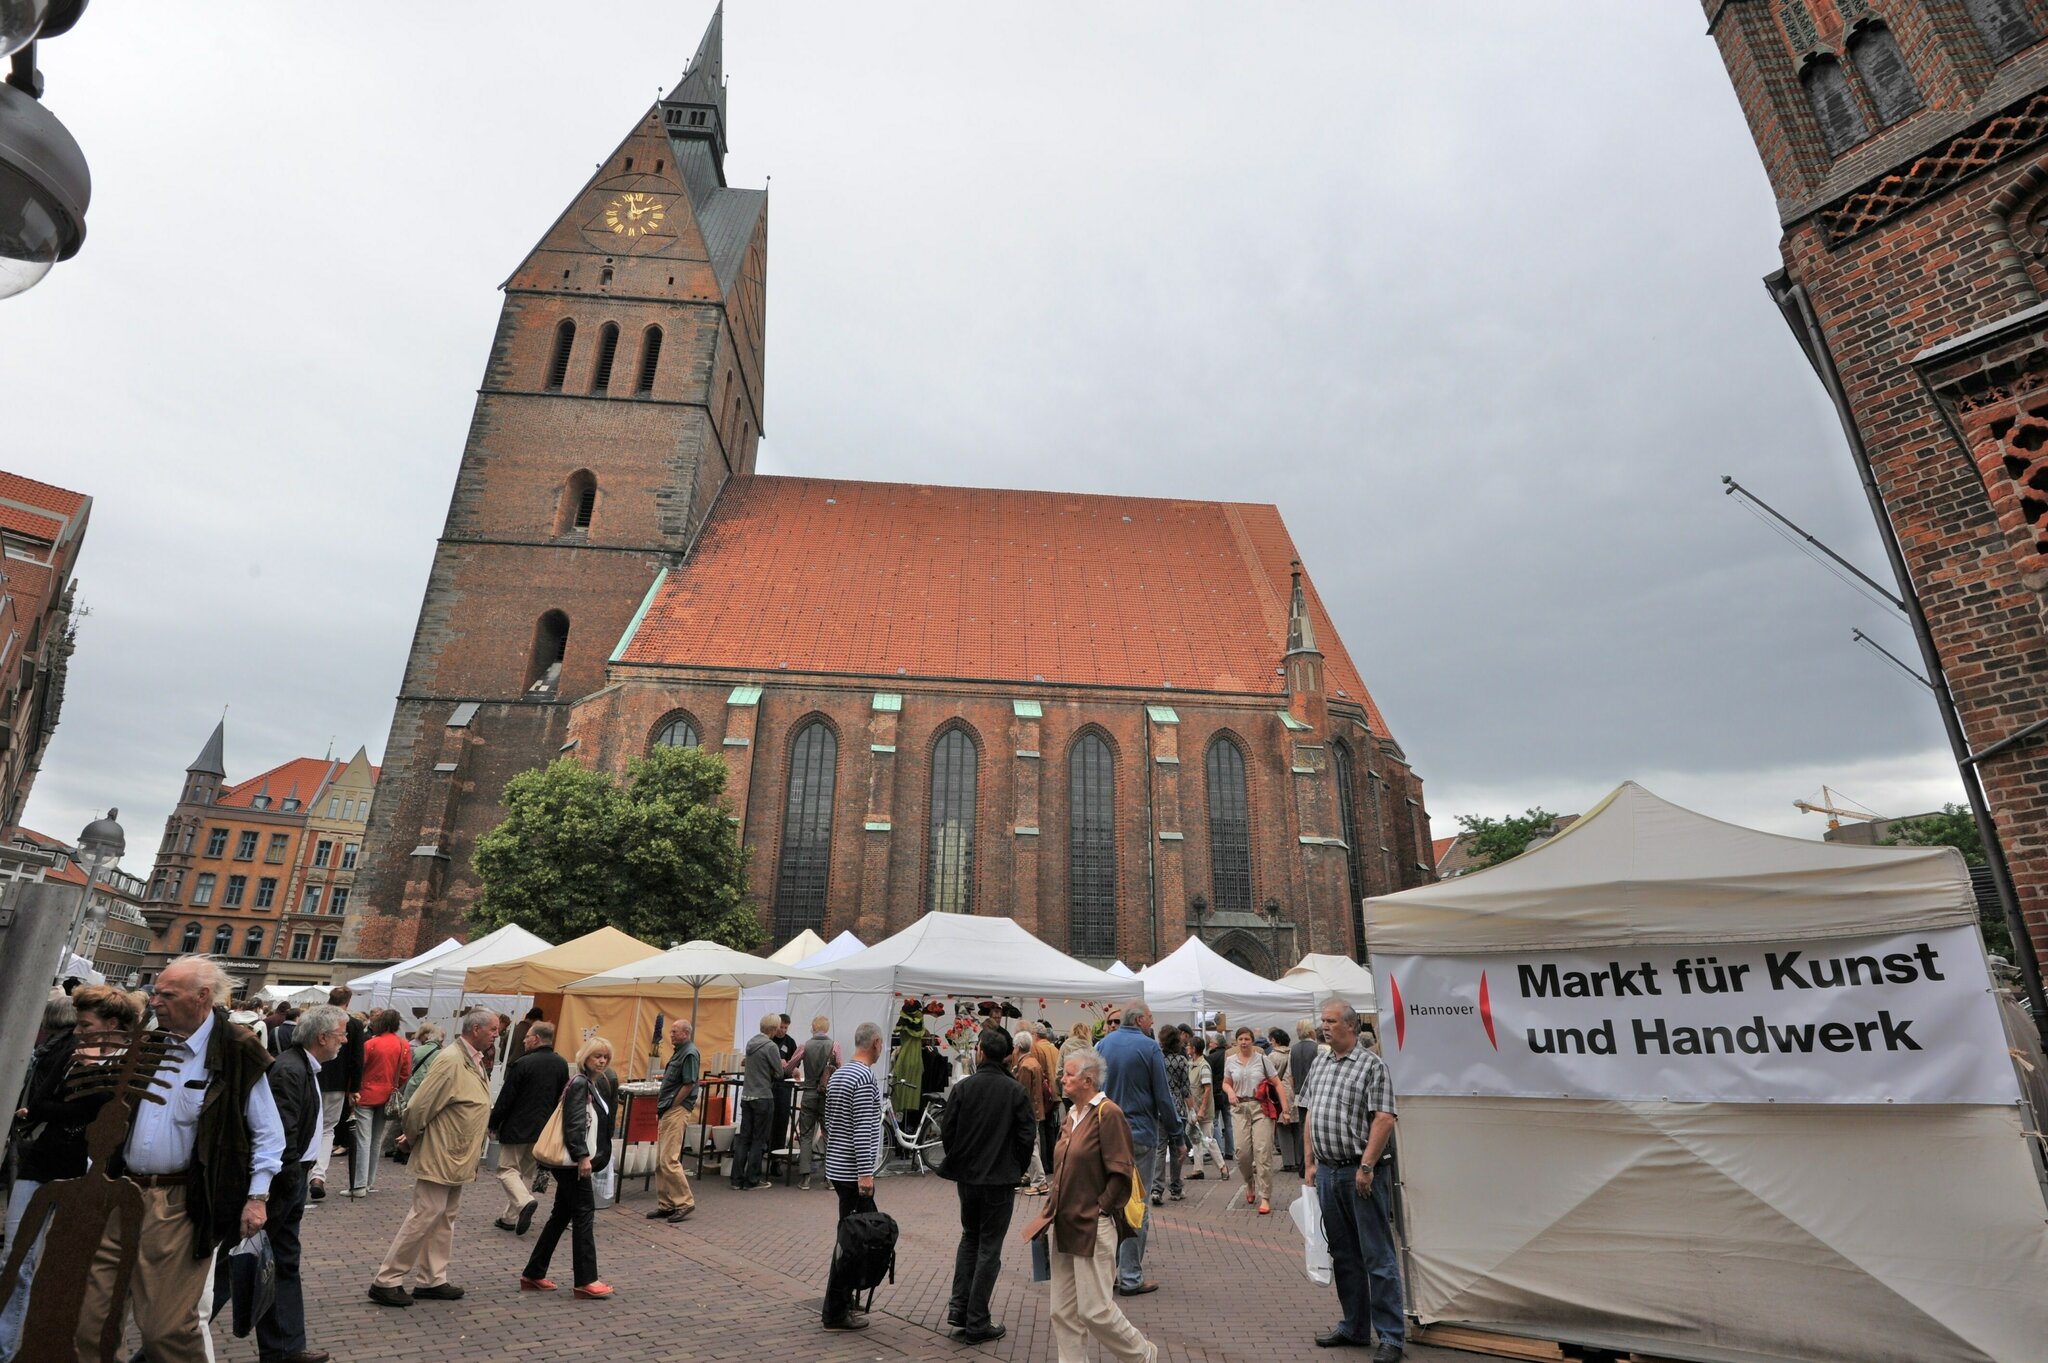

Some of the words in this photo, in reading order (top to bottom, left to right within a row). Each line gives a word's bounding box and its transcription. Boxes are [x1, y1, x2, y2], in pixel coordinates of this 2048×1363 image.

[1517, 960, 1661, 998] Markt
[1672, 956, 1750, 995] für
[1764, 943, 1945, 991] Kunst
[1410, 1004, 1474, 1016] Hannover
[1527, 1019, 1617, 1056] und
[1631, 1010, 1924, 1056] Handwerk
